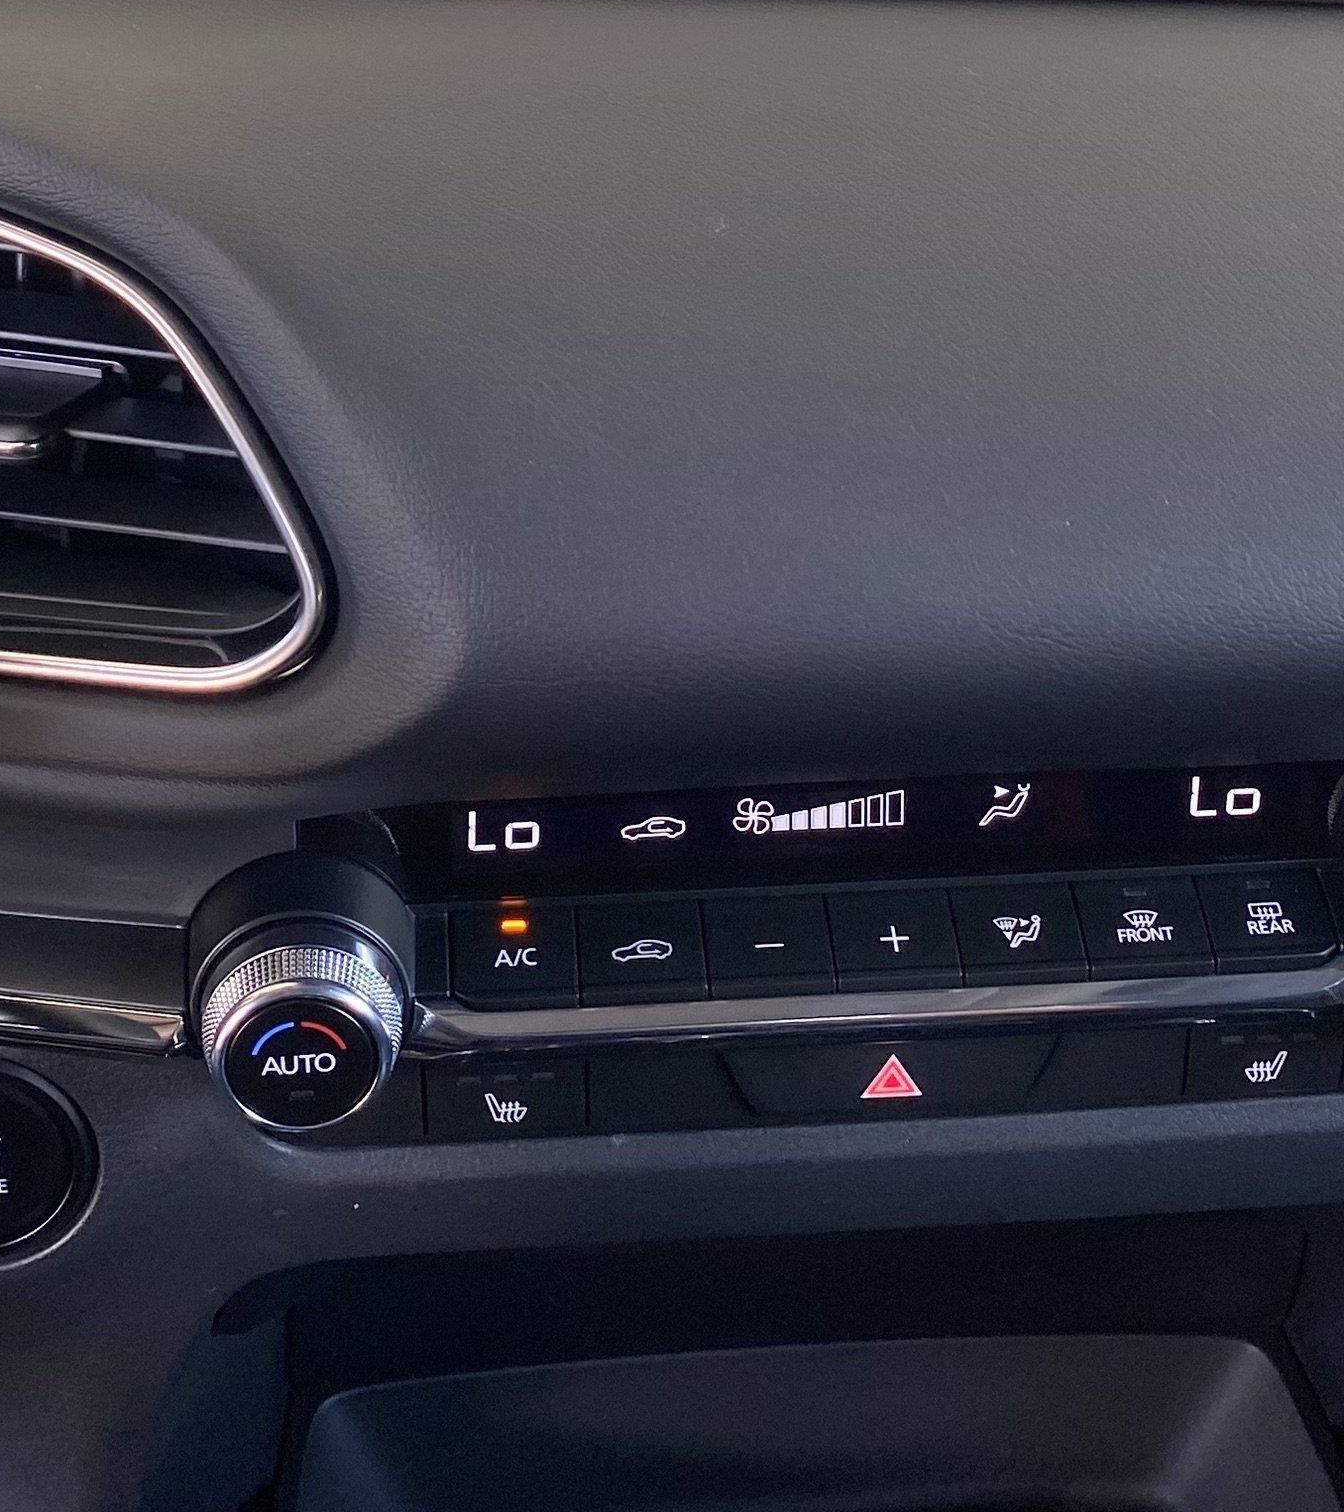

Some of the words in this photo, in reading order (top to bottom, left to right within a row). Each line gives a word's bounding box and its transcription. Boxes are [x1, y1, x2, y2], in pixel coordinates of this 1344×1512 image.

[1189, 775, 1261, 818] Lo
[467, 810, 540, 852] Lo
[1116, 925, 1174, 945] FRONT
[1246, 917, 1296, 937] REAR
[494, 947, 538, 968] A/C
[260, 1051, 337, 1078] AUTO
